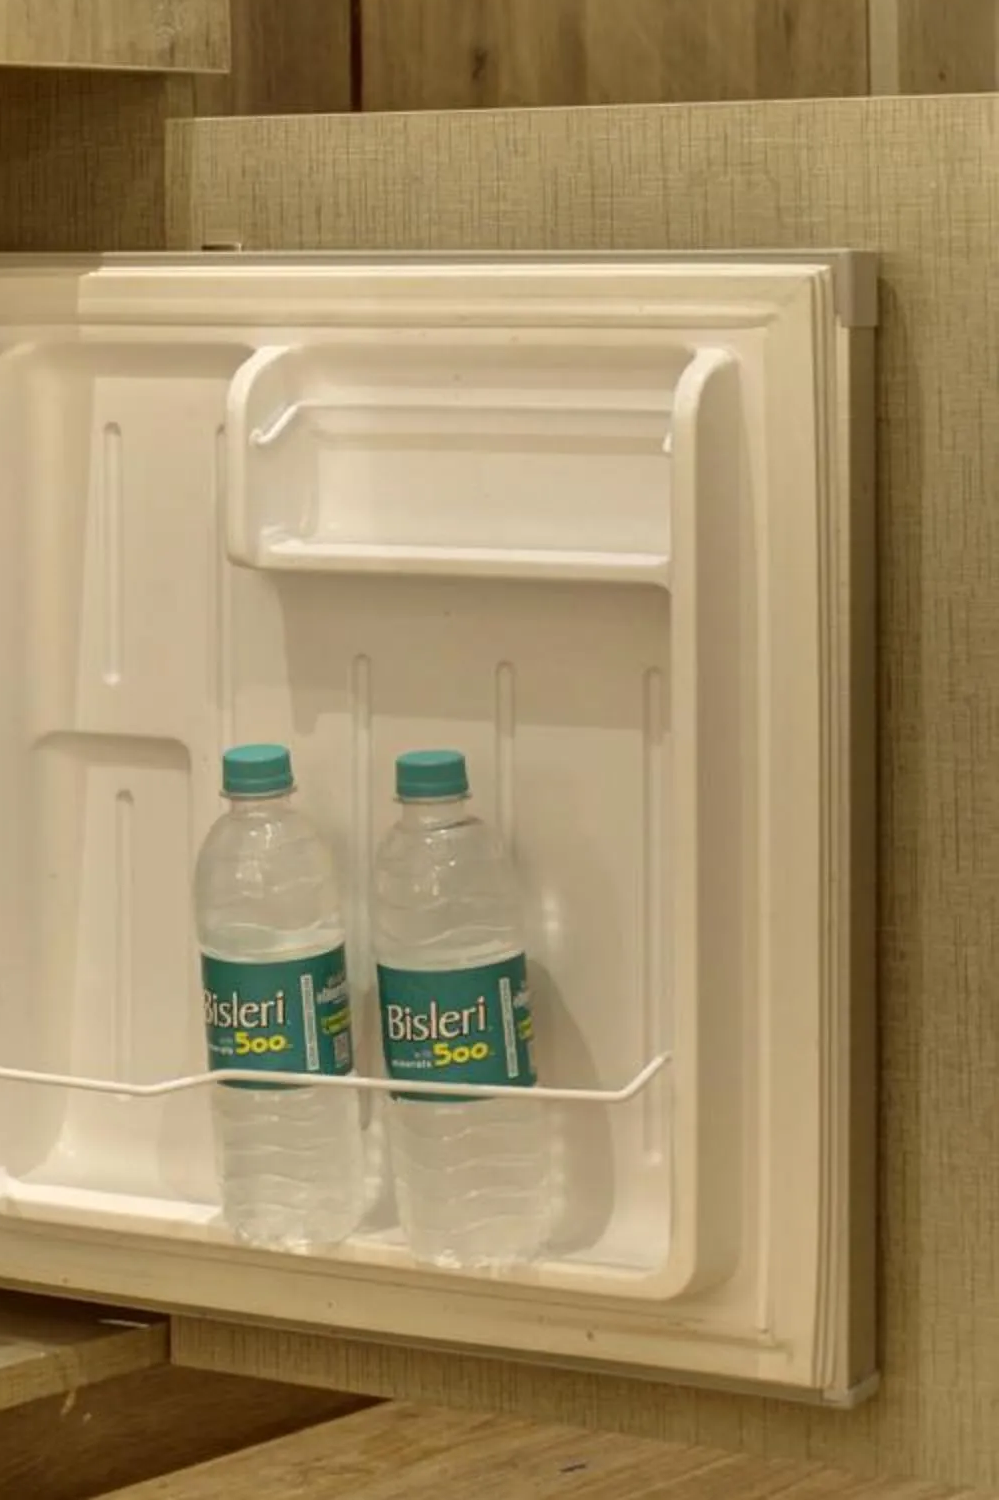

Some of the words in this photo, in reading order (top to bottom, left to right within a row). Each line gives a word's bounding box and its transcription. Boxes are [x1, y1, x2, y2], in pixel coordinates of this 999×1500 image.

[203, 990, 285, 1028] Bisleri
[386, 996, 485, 1041] Bisleri
[234, 1031, 286, 1055] 500
[433, 1042, 489, 1066] 500
